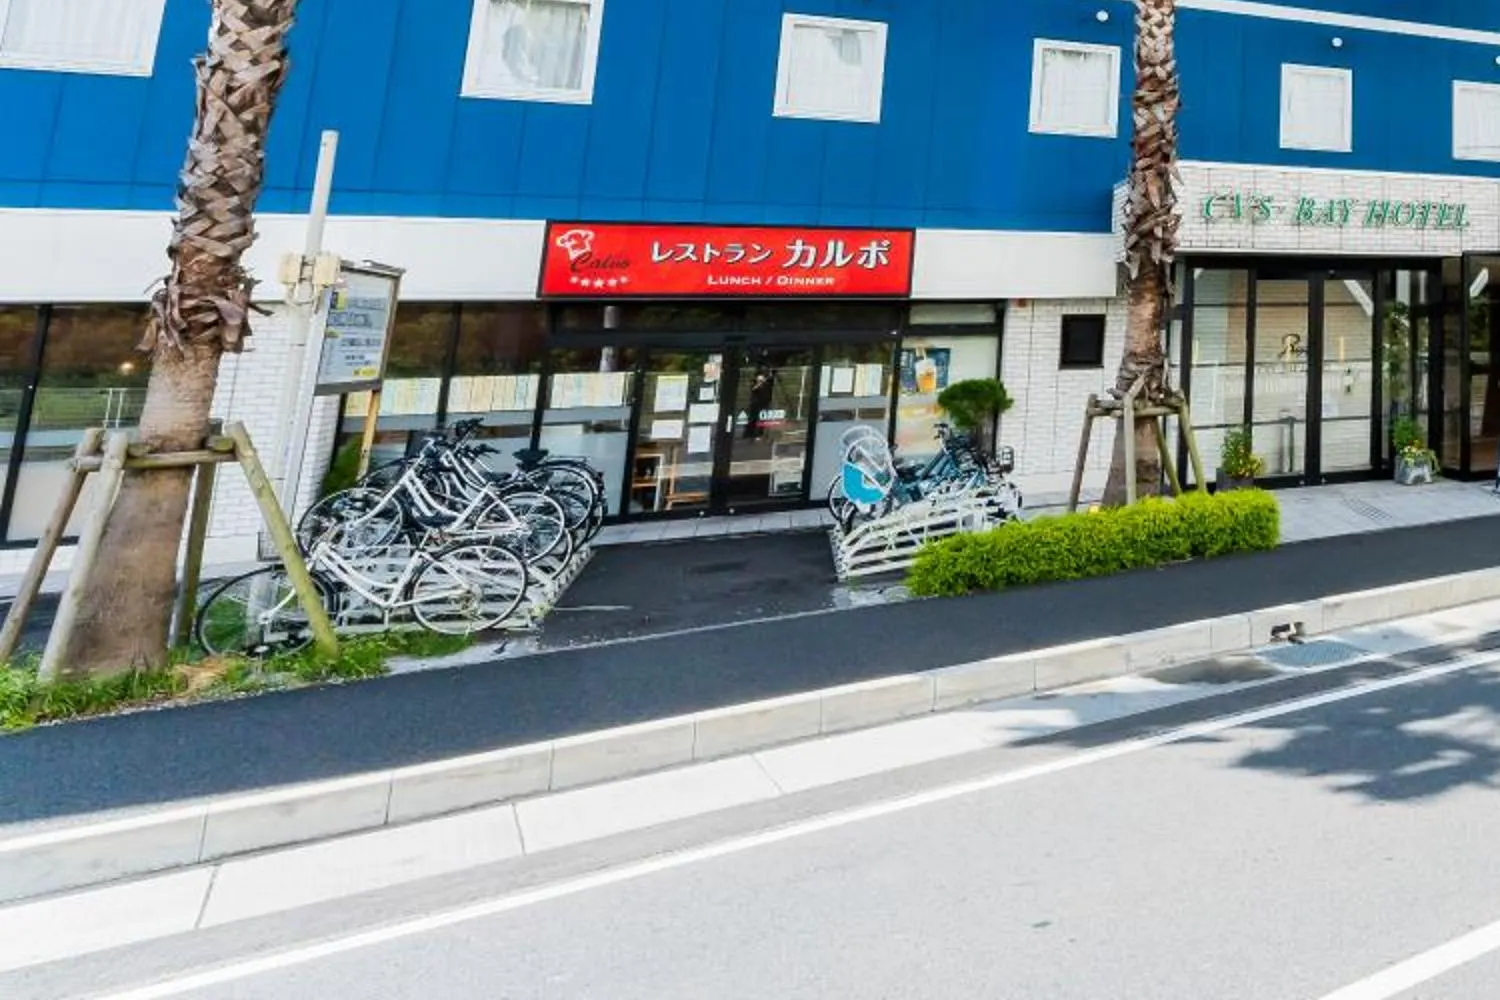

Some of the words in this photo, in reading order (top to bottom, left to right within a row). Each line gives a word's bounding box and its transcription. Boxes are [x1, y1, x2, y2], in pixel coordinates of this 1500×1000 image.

[1363, 198, 1471, 229] HOTEL
[651, 241, 773, 264] レストラン
[783, 239, 893, 270] カルボ
[707, 274, 762, 286] LUNCH
[777, 275, 836, 287] DINNER
